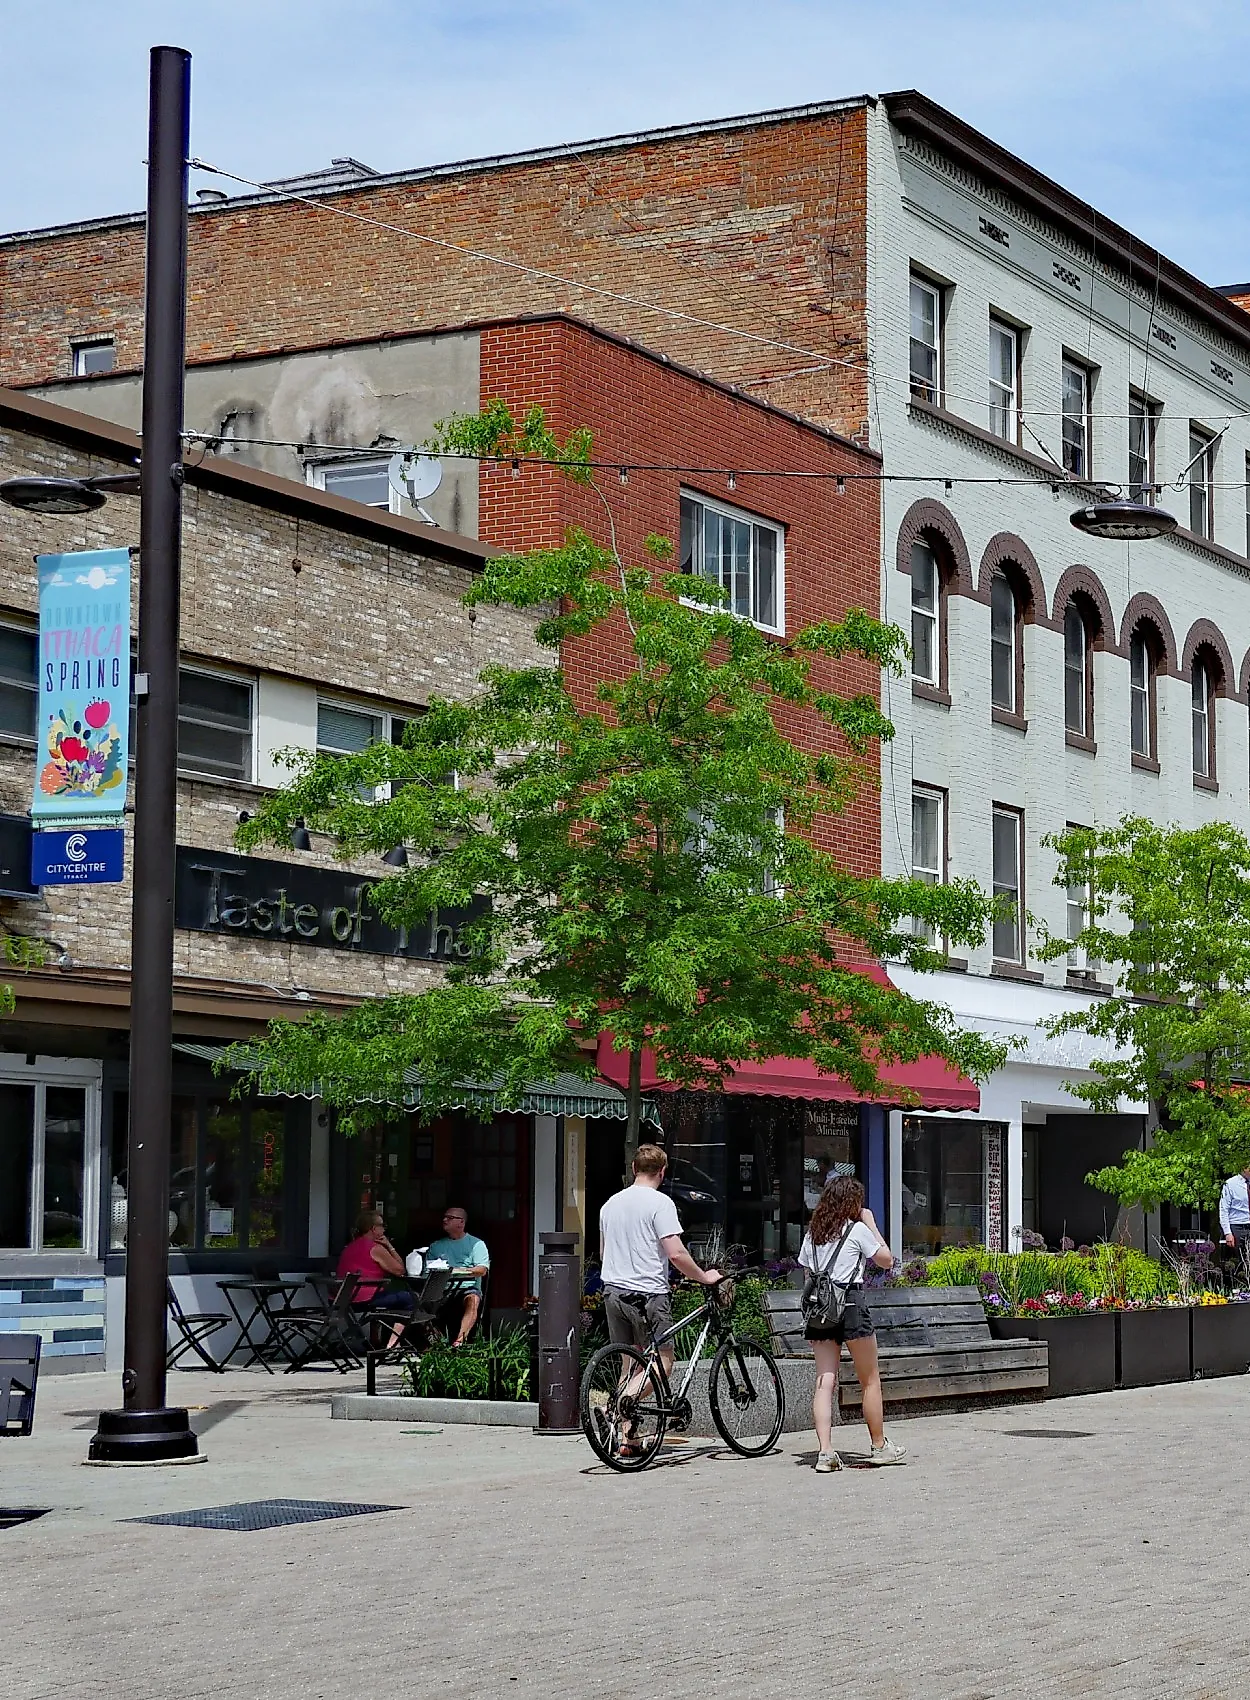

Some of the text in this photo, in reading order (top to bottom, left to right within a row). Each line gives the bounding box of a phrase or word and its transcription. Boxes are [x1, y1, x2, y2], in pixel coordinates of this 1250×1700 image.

[46, 602, 121, 627] DOWNTOWN
[44, 624, 122, 660] ITHACA
[46, 658, 119, 692] SPRING
[46, 862, 106, 874] CITYCENTRE
[190, 863, 319, 936] Taste
[331, 881, 374, 943] of
[806, 1110, 858, 1125] Multi-Faceted
[816, 1124, 849, 1136] Minerals
